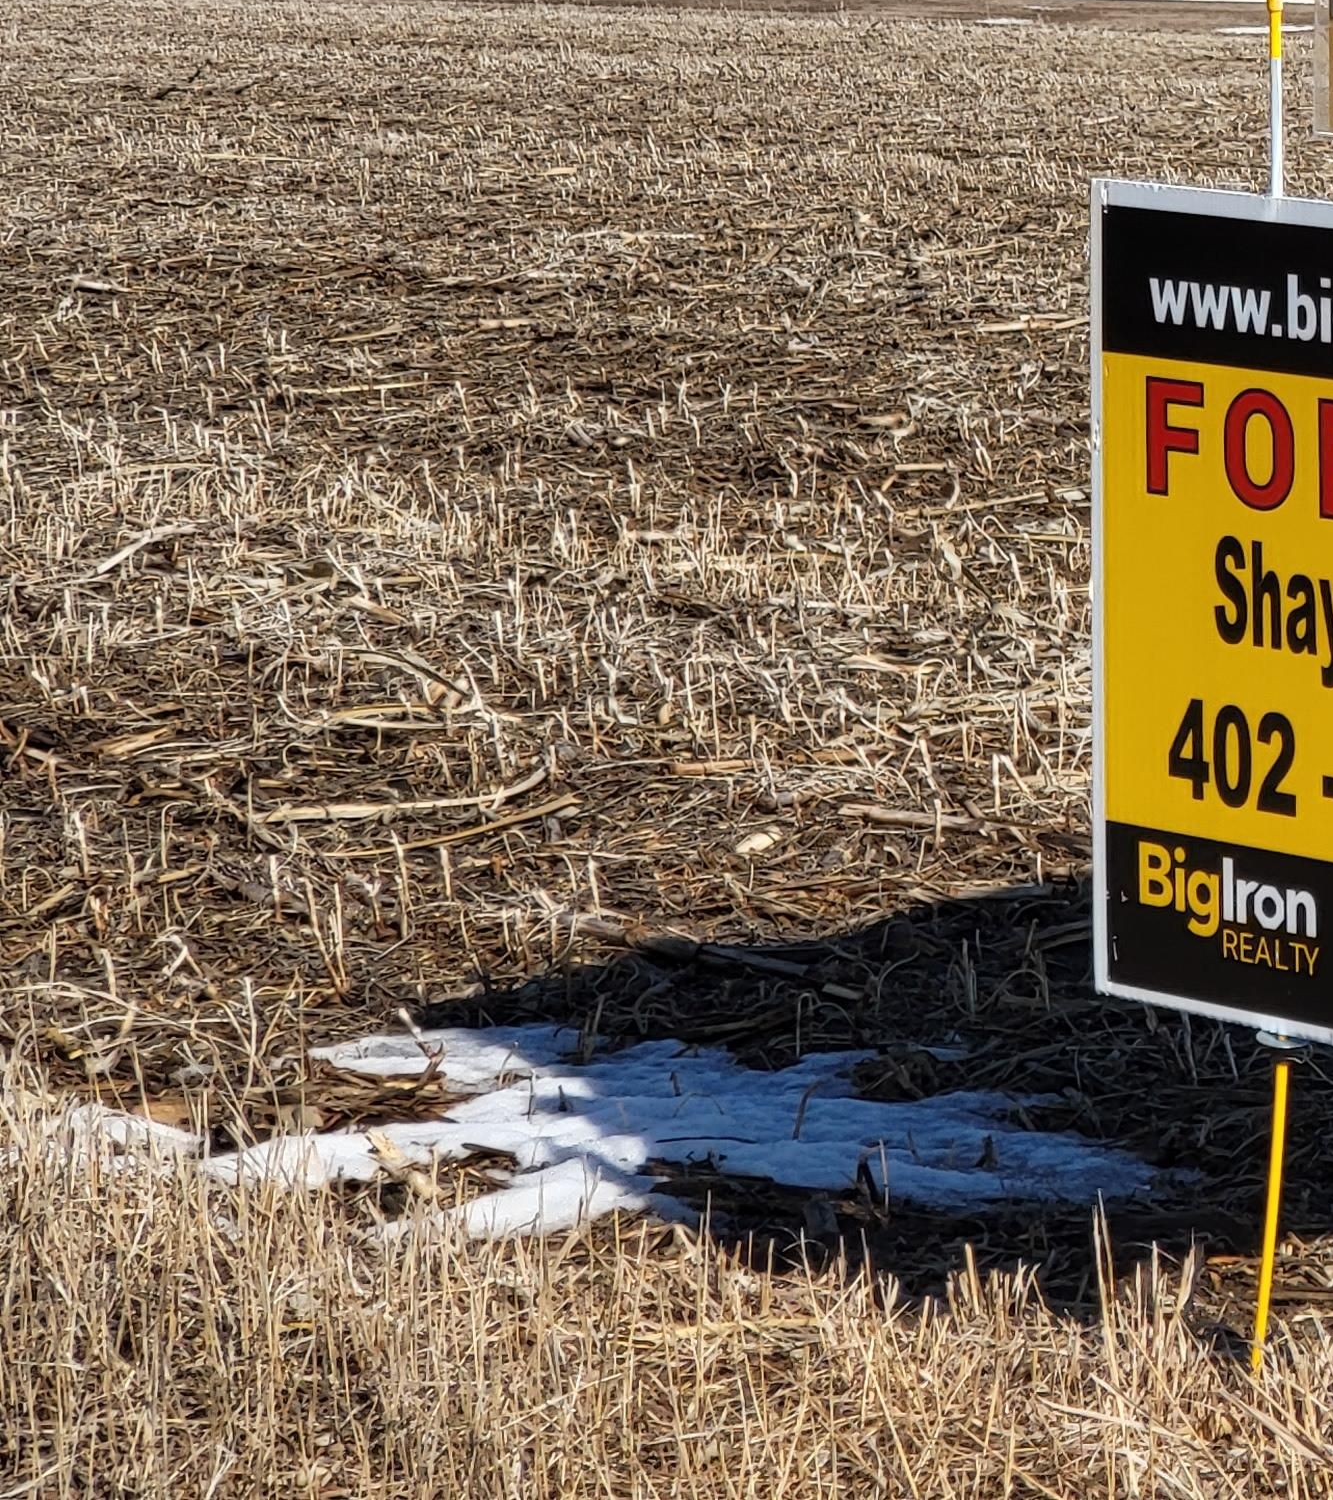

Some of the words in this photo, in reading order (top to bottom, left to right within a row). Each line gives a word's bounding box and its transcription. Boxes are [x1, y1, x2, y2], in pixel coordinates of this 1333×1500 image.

[1168, 698, 1297, 817] 402
[1138, 841, 1318, 938] BigIron
[1222, 930, 1320, 977] REALTY
